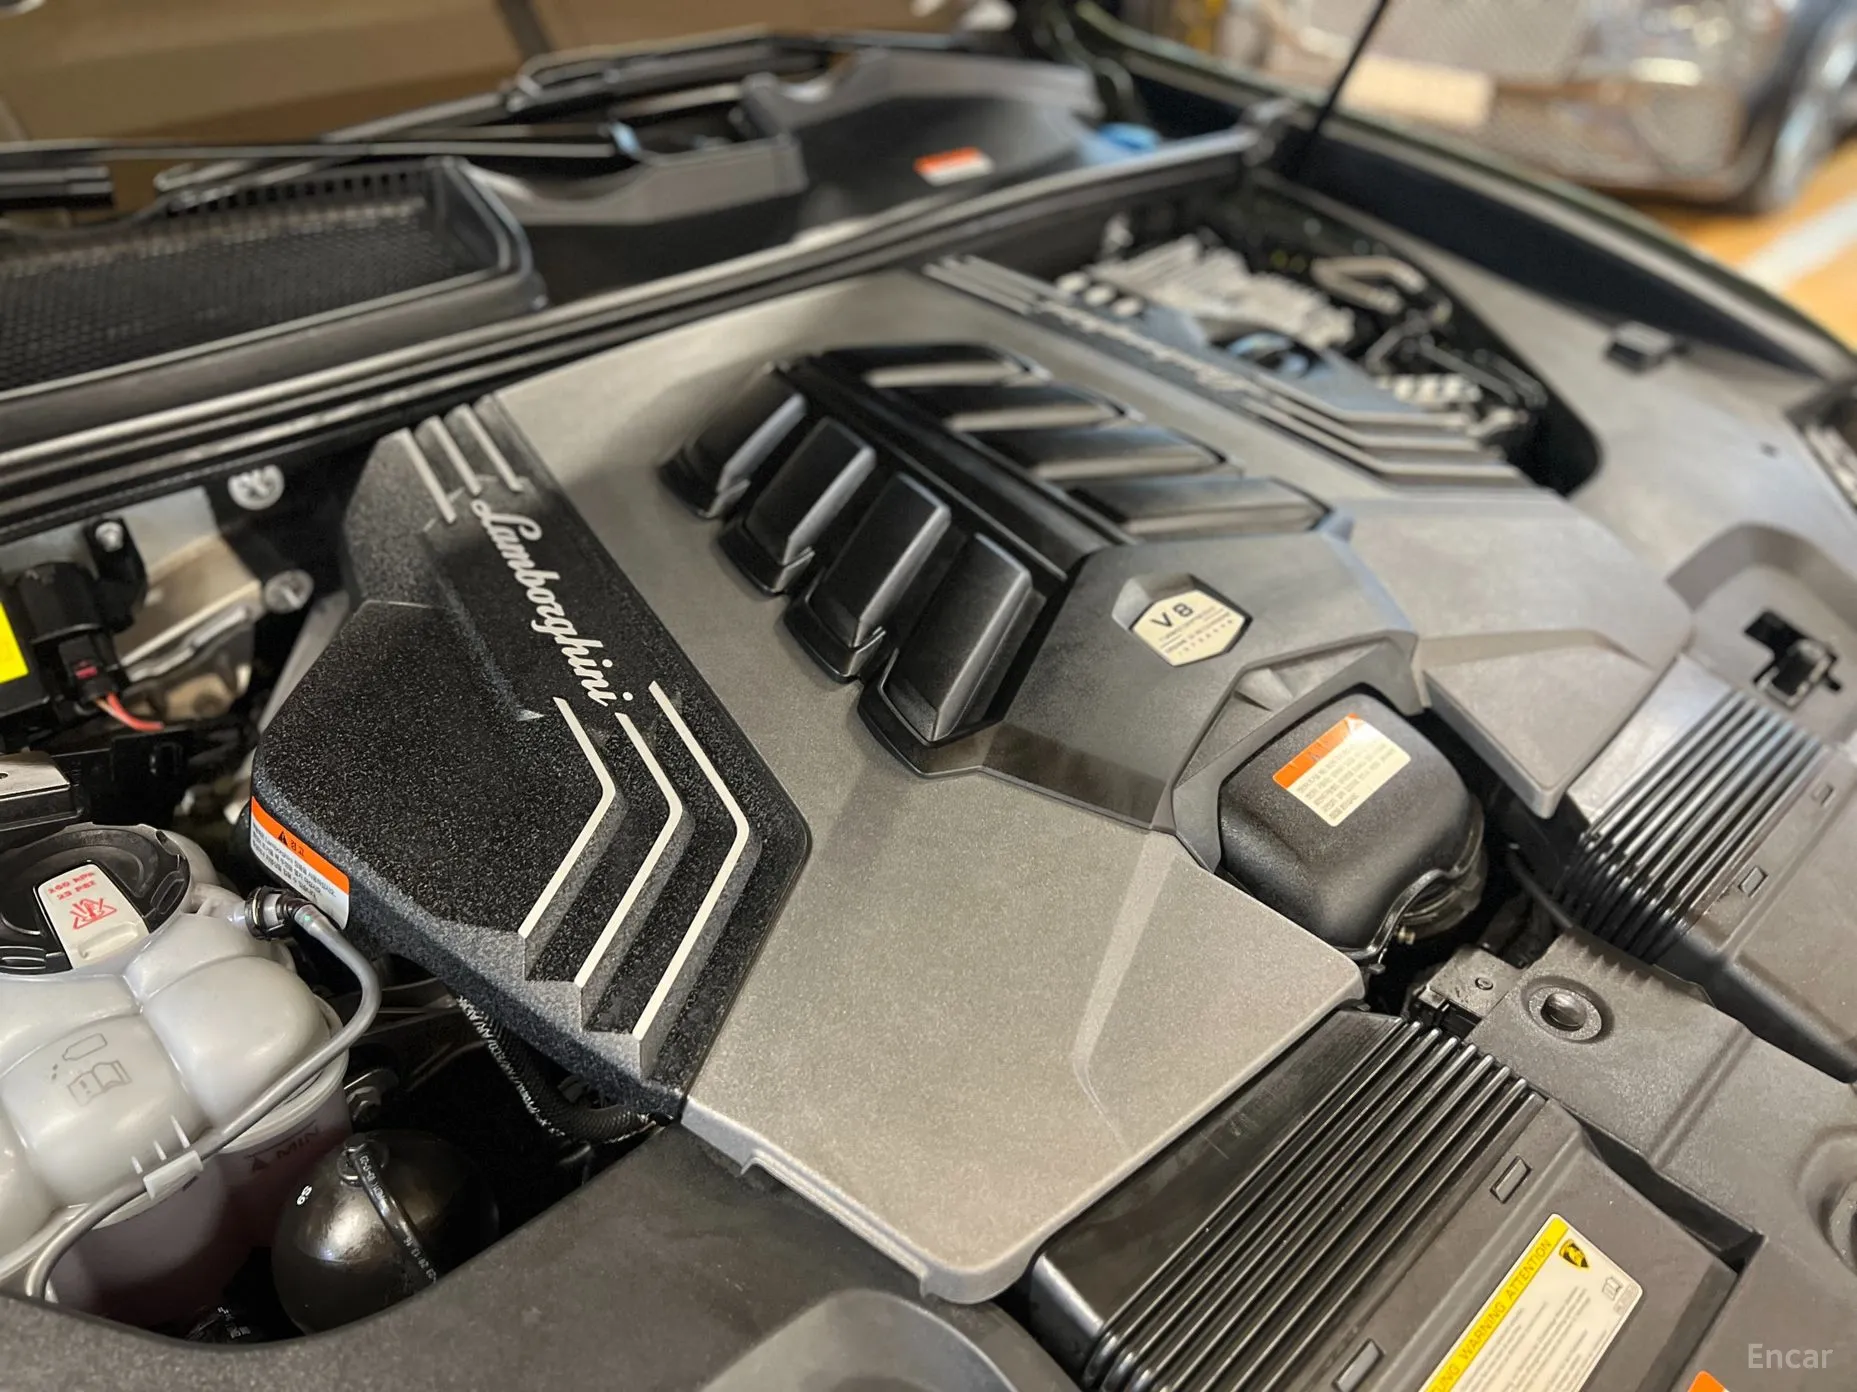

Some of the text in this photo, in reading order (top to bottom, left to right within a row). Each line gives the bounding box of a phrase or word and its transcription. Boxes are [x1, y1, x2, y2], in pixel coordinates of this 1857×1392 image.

[471, 499, 633, 707] Lamborghini
[1150, 602, 1194, 628] V8
[277, 1124, 320, 1160] MIN
[1459, 1301, 1506, 1359] WARNING
[1505, 1239, 1552, 1299] ATTENTION
